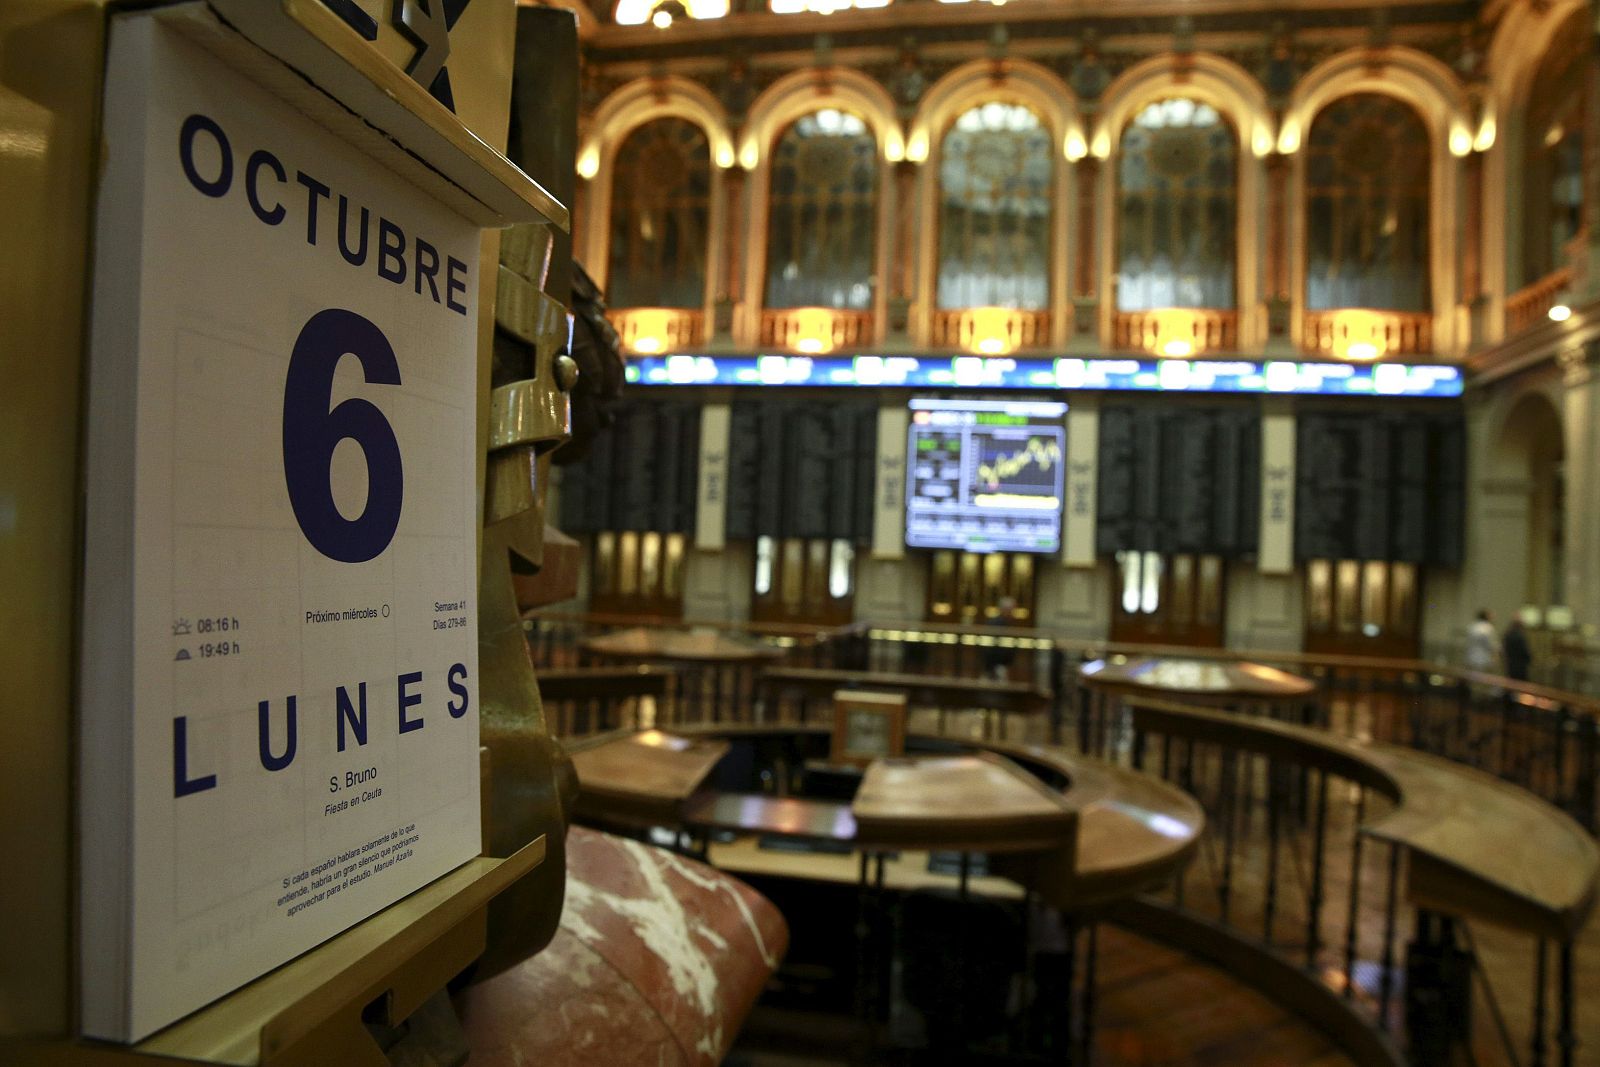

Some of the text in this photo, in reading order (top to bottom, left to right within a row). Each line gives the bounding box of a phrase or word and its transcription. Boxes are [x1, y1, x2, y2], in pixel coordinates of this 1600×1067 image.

[179, 113, 468, 316] OCTUBRE
[282, 308, 404, 564] 6
[197, 617, 239, 633] 08:16 h
[306, 605, 378, 624] Próximo miércoles
[434, 600, 466, 612] Semana 41
[199, 642, 240, 659] 19:49 h
[173, 662, 469, 799] LUNES
[325, 788, 382, 817] Fiesta en Ceuta
[329, 766, 377, 794] S. Bruno
[277, 885, 310, 907] entiende,
[333, 870, 342, 880] un
[343, 863, 358, 878] gran
[358, 852, 380, 869] silencio
[380, 846, 391, 859] que
[283, 822, 416, 889] Si cada español hablara solamente de lo que
[287, 849, 413, 918] aprovechar para el estudio. Manuel Azaña
